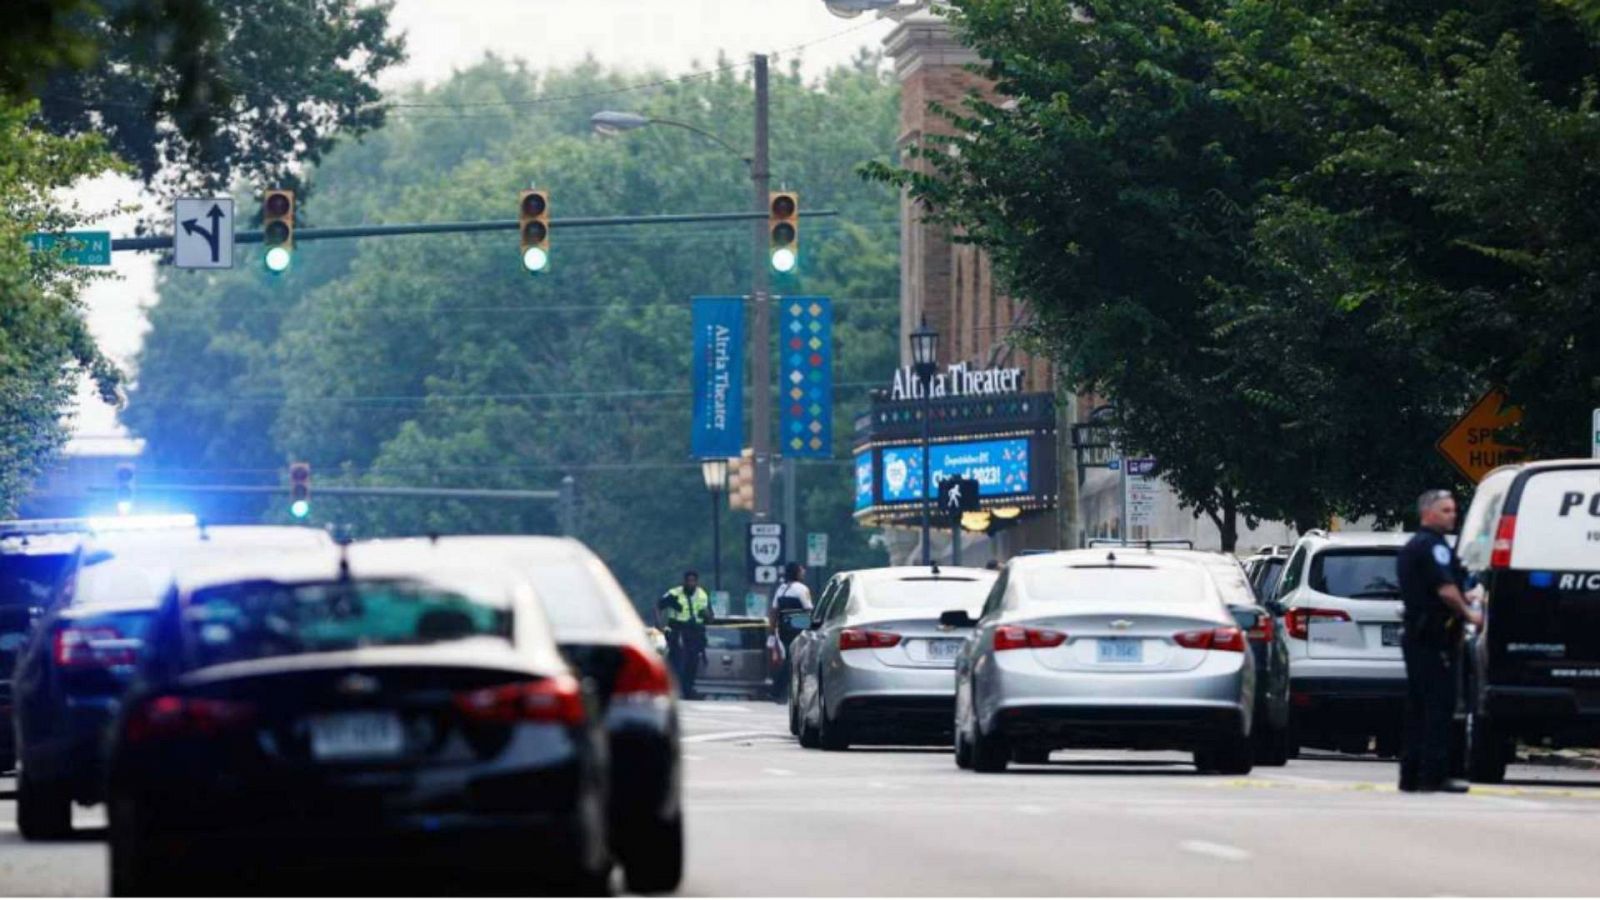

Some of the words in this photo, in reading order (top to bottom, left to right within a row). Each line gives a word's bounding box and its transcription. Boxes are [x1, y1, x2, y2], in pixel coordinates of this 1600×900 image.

[92, 240, 104, 252] N
[714, 324, 730, 370] Altria
[891, 364, 946, 400] Altia
[948, 360, 1020, 396] Theater
[714, 372, 730, 431] Theater
[754, 543, 777, 554] 147
